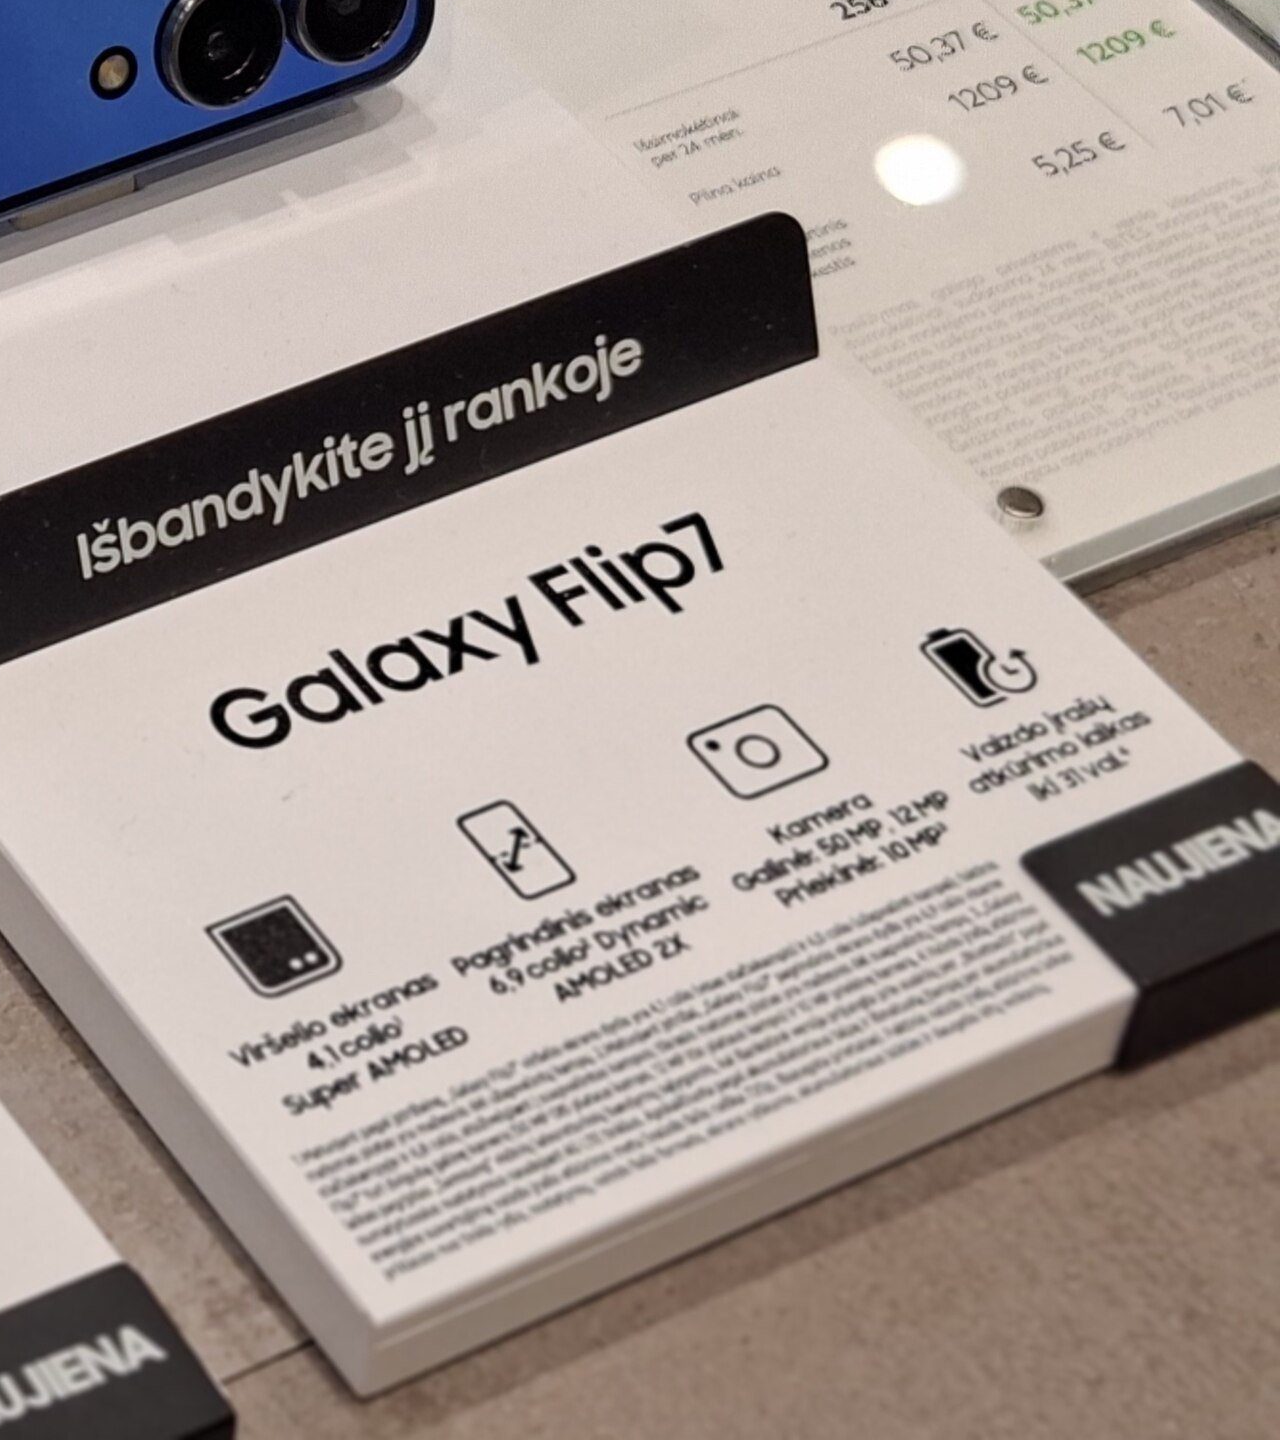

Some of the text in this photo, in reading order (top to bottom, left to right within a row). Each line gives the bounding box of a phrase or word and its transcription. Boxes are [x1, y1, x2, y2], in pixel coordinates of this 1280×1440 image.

[889, 32, 968, 72] 50,37
[972, 21, 1000, 45] €
[947, 18, 1177, 113] 1209 € 1209 €
[1032, 80, 1256, 179] 5,25 € 7,01 €
[76, 333, 643, 580] Išbandykite jį rankoje
[209, 511, 726, 750] Galaxy Flip7
[958, 721, 1050, 763] Vaizdo
[967, 739, 1081, 795] atkūrimo
[766, 792, 874, 846] Kamera
[815, 831, 851, 857] 50
[886, 803, 919, 827] 12
[912, 789, 950, 818] MP
[878, 838, 911, 863] 10
[1075, 806, 1280, 918] NAUJIENA
[450, 864, 702, 978] Pagrindinis ekranas
[592, 893, 710, 952] Dynamic
[329, 973, 439, 1029] ekranas
[552, 932, 692, 1004] AMOLED 2X
[281, 1025, 469, 1116] Super AMOLED
